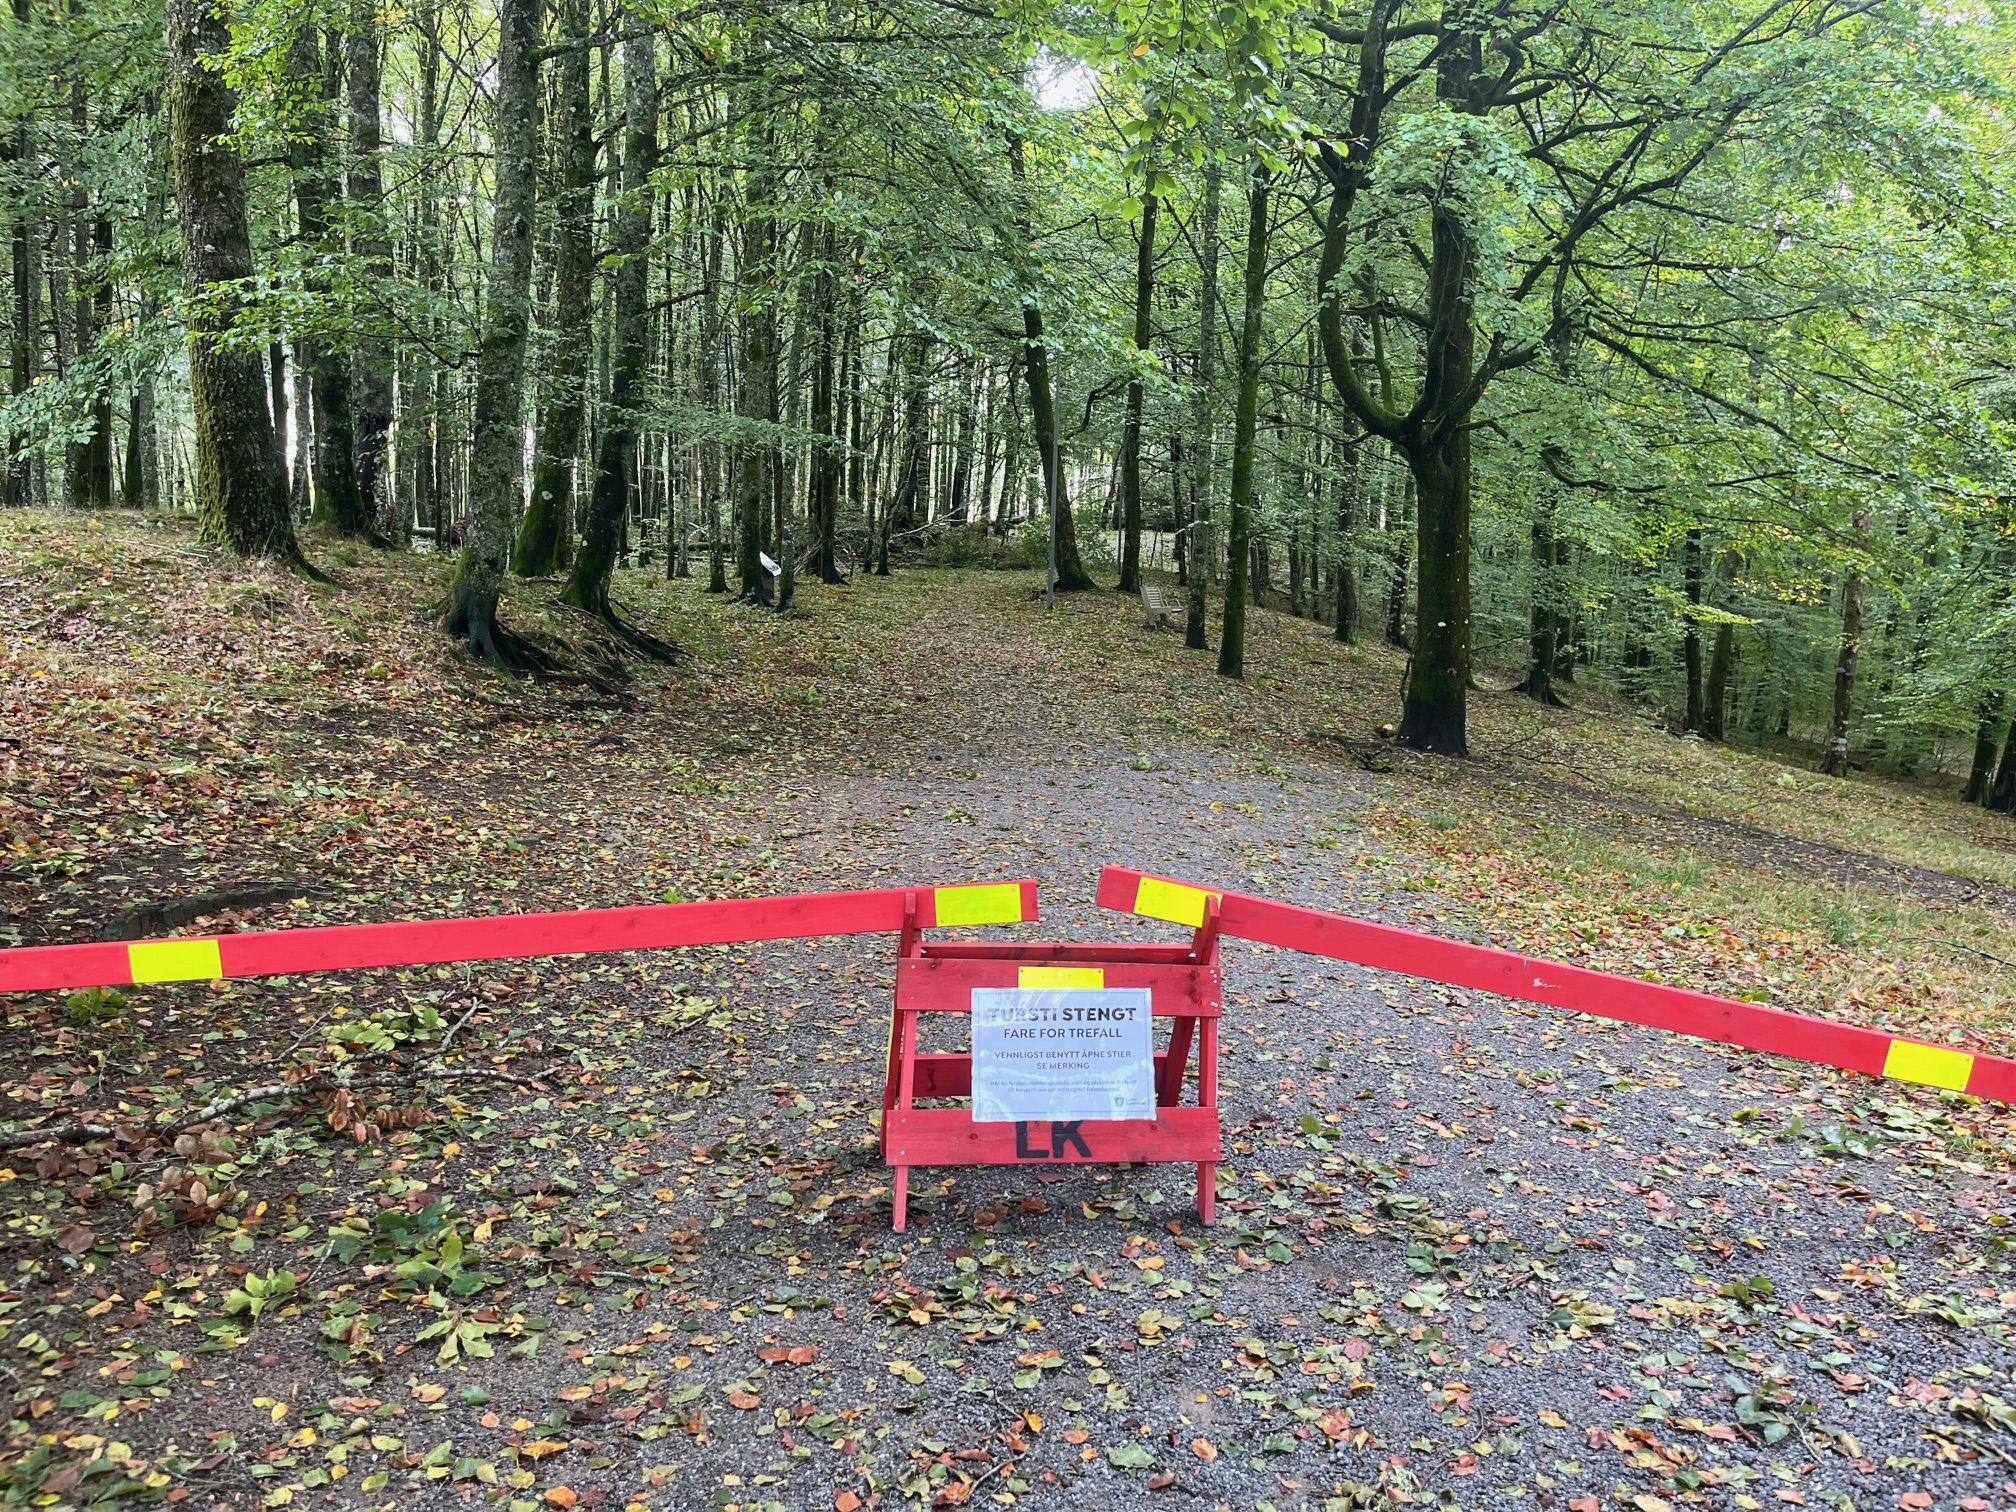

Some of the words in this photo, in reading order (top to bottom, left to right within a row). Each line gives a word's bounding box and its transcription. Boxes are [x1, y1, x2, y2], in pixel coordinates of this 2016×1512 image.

[987, 1007, 1057, 1021] TURSTI
[1062, 1007, 1137, 1021] STENGT
[1004, 1028, 1036, 1038] FARE
[1040, 1028, 1066, 1038] FOR
[1068, 1028, 1122, 1038] TREFALL
[994, 1051, 1045, 1059] VENNLIGST
[1046, 1050, 1080, 1058] BENYTT
[1081, 1048, 1105, 1058] ÅPNE
[1107, 1050, 1131, 1058] STIER
[1036, 1062, 1048, 1070] SE
[1049, 1062, 1090, 1070] MERKING
[1015, 1119, 1092, 1159] LK
